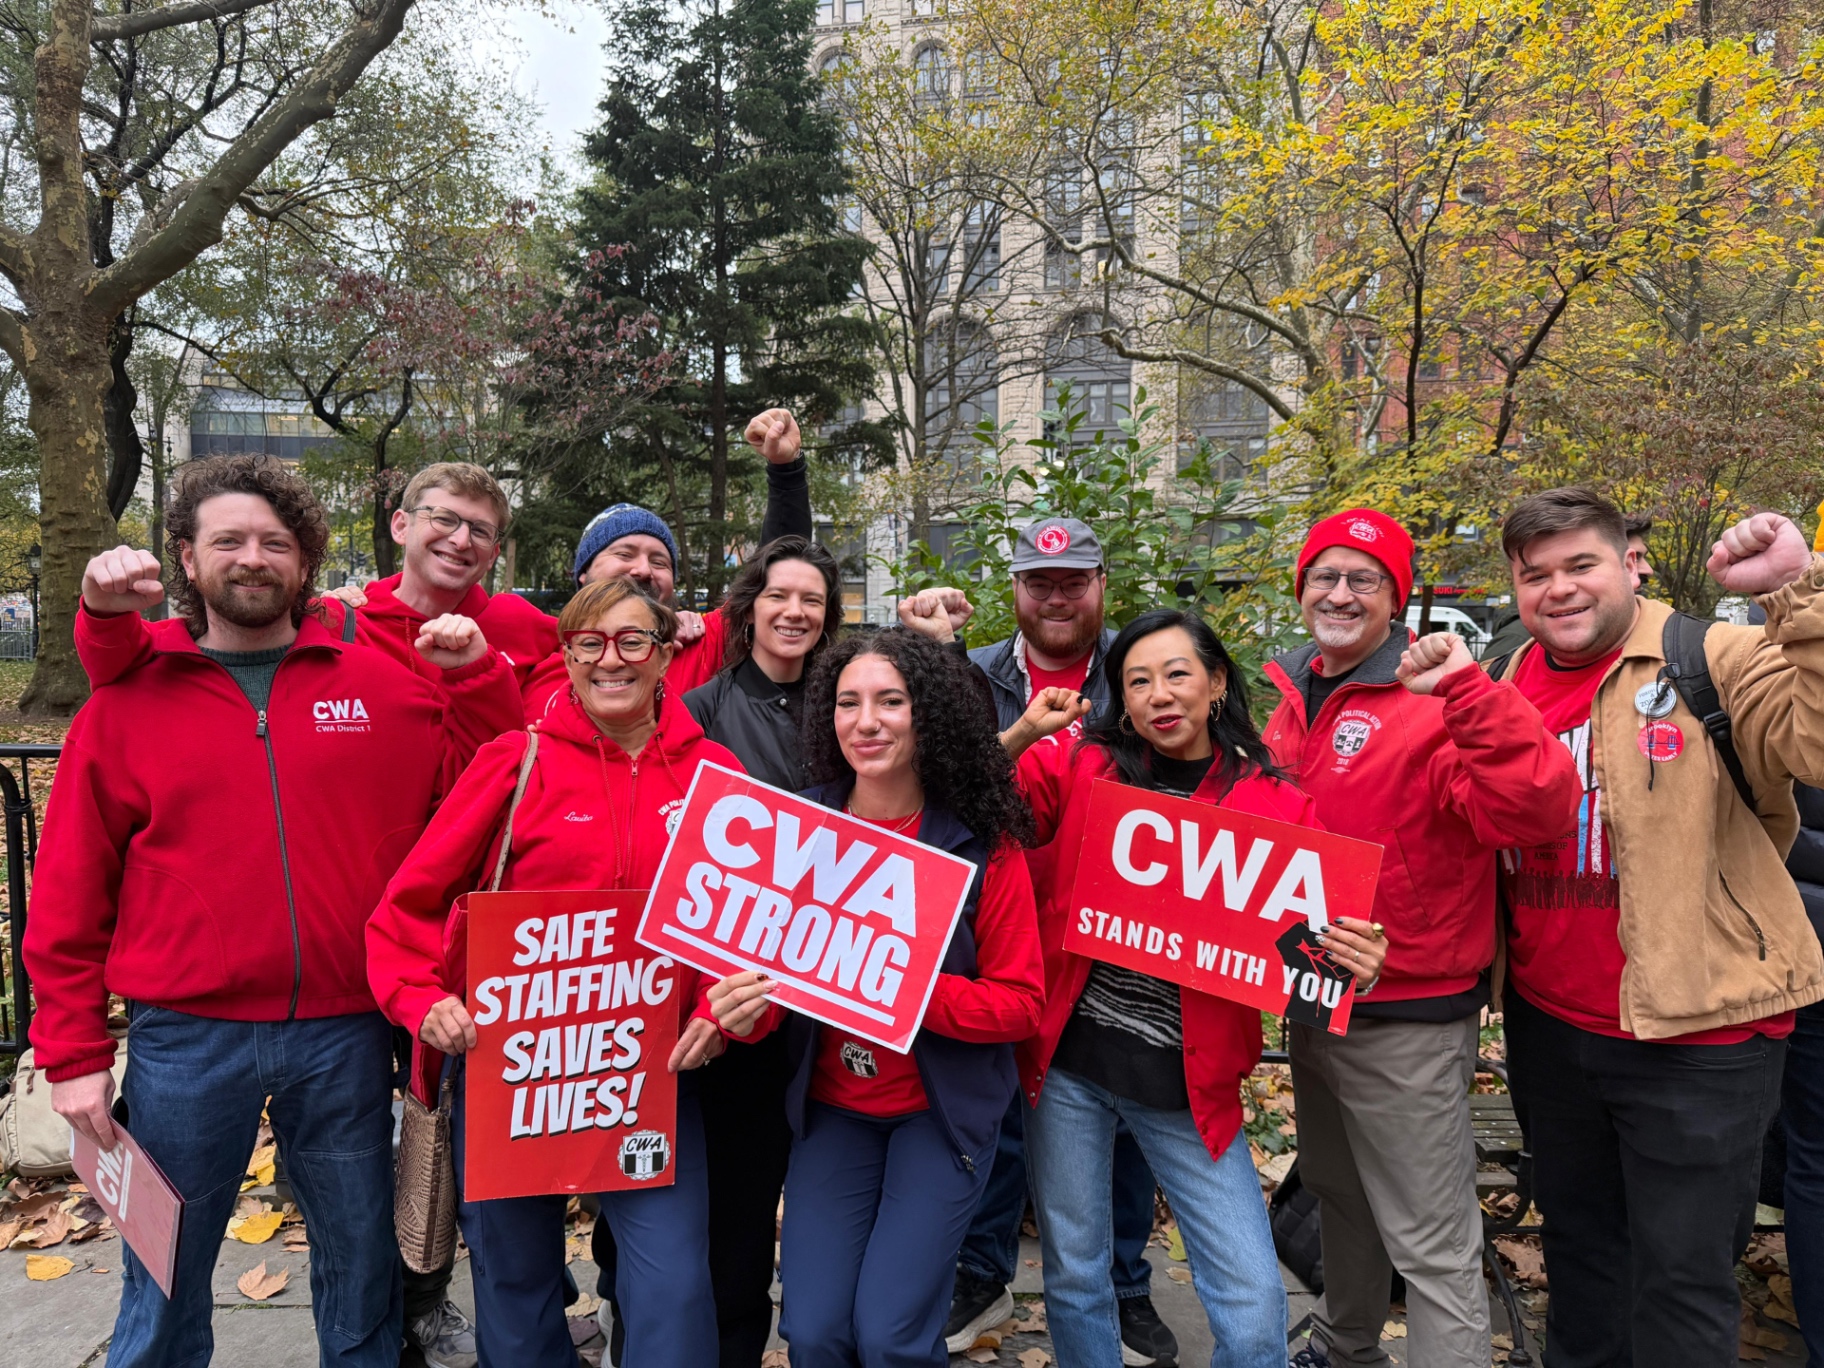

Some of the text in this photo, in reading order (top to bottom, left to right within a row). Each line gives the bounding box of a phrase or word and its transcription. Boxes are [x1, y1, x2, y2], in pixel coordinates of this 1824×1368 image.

[313, 698, 369, 720] CWA
[337, 724, 365, 732] District
[1341, 710, 1371, 720] POLITICAL
[1341, 723, 1367, 737] CWA
[702, 794, 917, 938] CWA
[1111, 808, 1329, 934] CWA
[512, 908, 618, 967] SAFE
[676, 861, 911, 1008] STRONG
[1077, 906, 1343, 1009] STANDS WITH YOU
[474, 956, 674, 1026] STAFFING
[502, 1017, 645, 1085] SAVES
[844, 1046, 870, 1063] CWA
[510, 1072, 647, 1141] LIVES!
[626, 1136, 662, 1152] CWA
